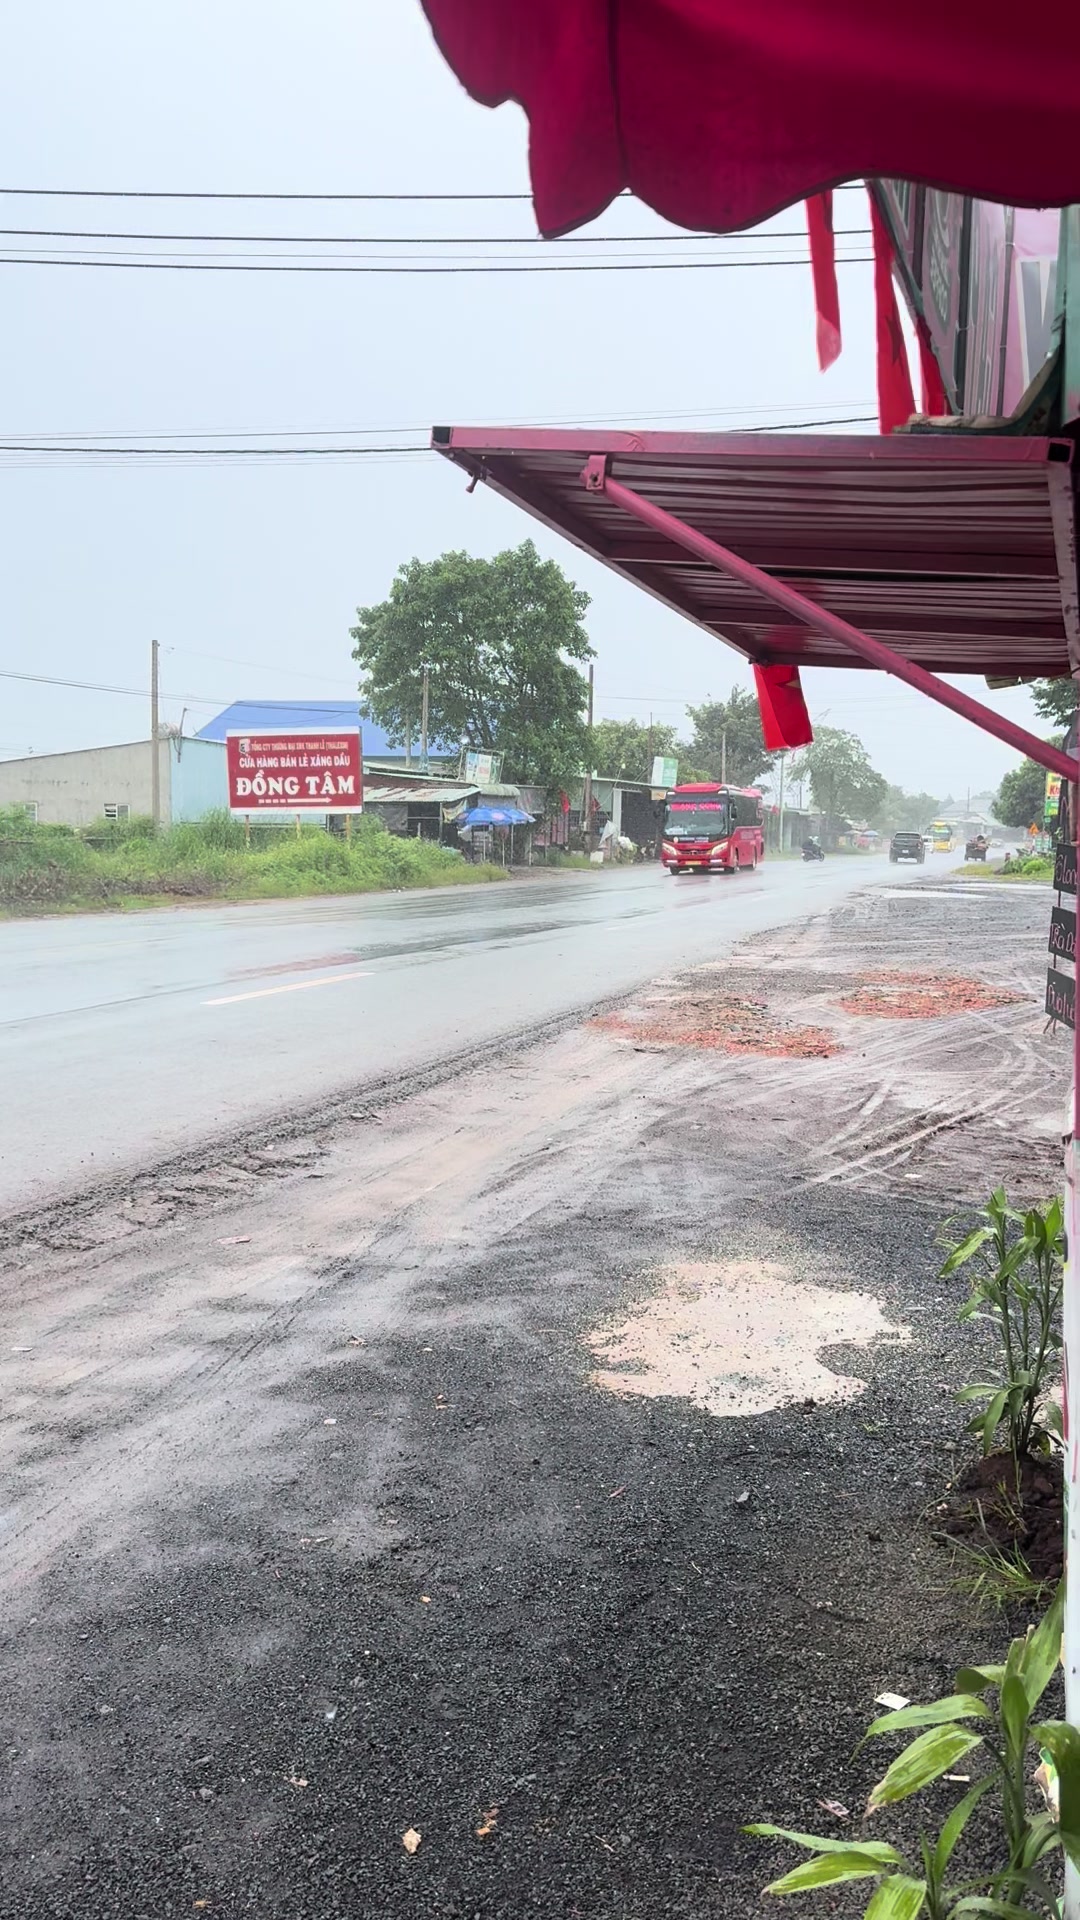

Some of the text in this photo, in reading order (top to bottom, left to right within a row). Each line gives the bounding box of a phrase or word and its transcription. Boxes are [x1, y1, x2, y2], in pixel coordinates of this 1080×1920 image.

[239, 753, 256, 768] CỬA
[256, 754, 279, 768] HÀNG
[280, 754, 297, 768] BÁN
[298, 752, 309, 767] LẺ
[310, 753, 332, 767] XĂNG
[236, 769, 355, 796] ĐỒNG TÂM
